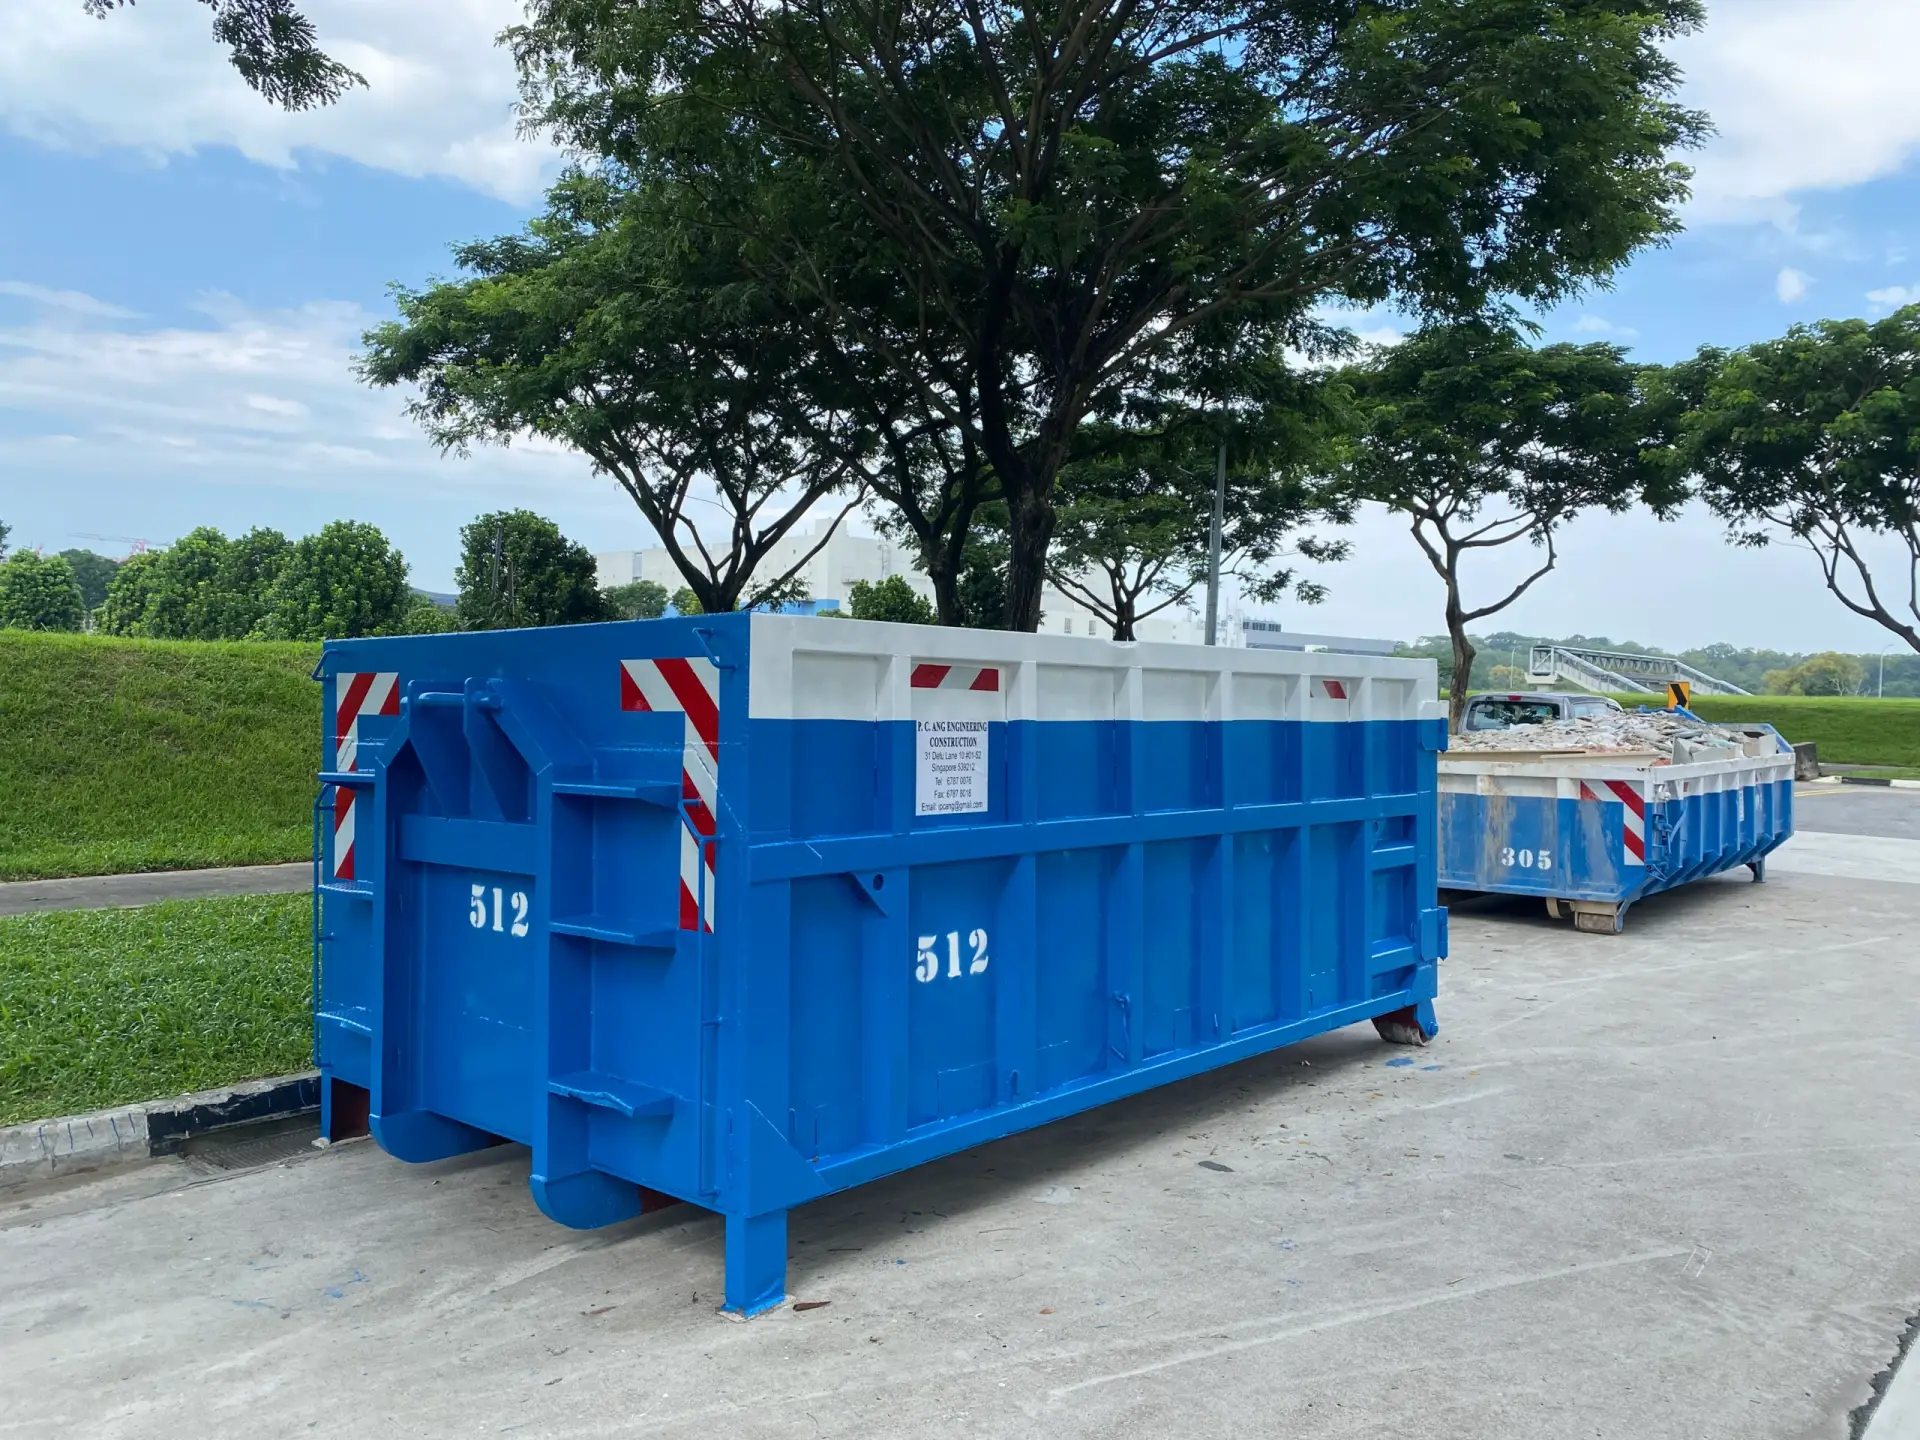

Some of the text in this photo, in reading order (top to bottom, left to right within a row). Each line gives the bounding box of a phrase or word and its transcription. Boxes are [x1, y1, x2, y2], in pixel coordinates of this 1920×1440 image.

[918, 721, 988, 732] P. C. ANG ENGINEERING
[929, 737, 977, 747] CONSTRUCTION
[924, 751, 931, 760] 31
[945, 751, 958, 760] Lane
[931, 763, 957, 774] Singapore
[1502, 847, 1552, 870] 305
[469, 884, 529, 938] 512
[915, 928, 989, 983] 512
